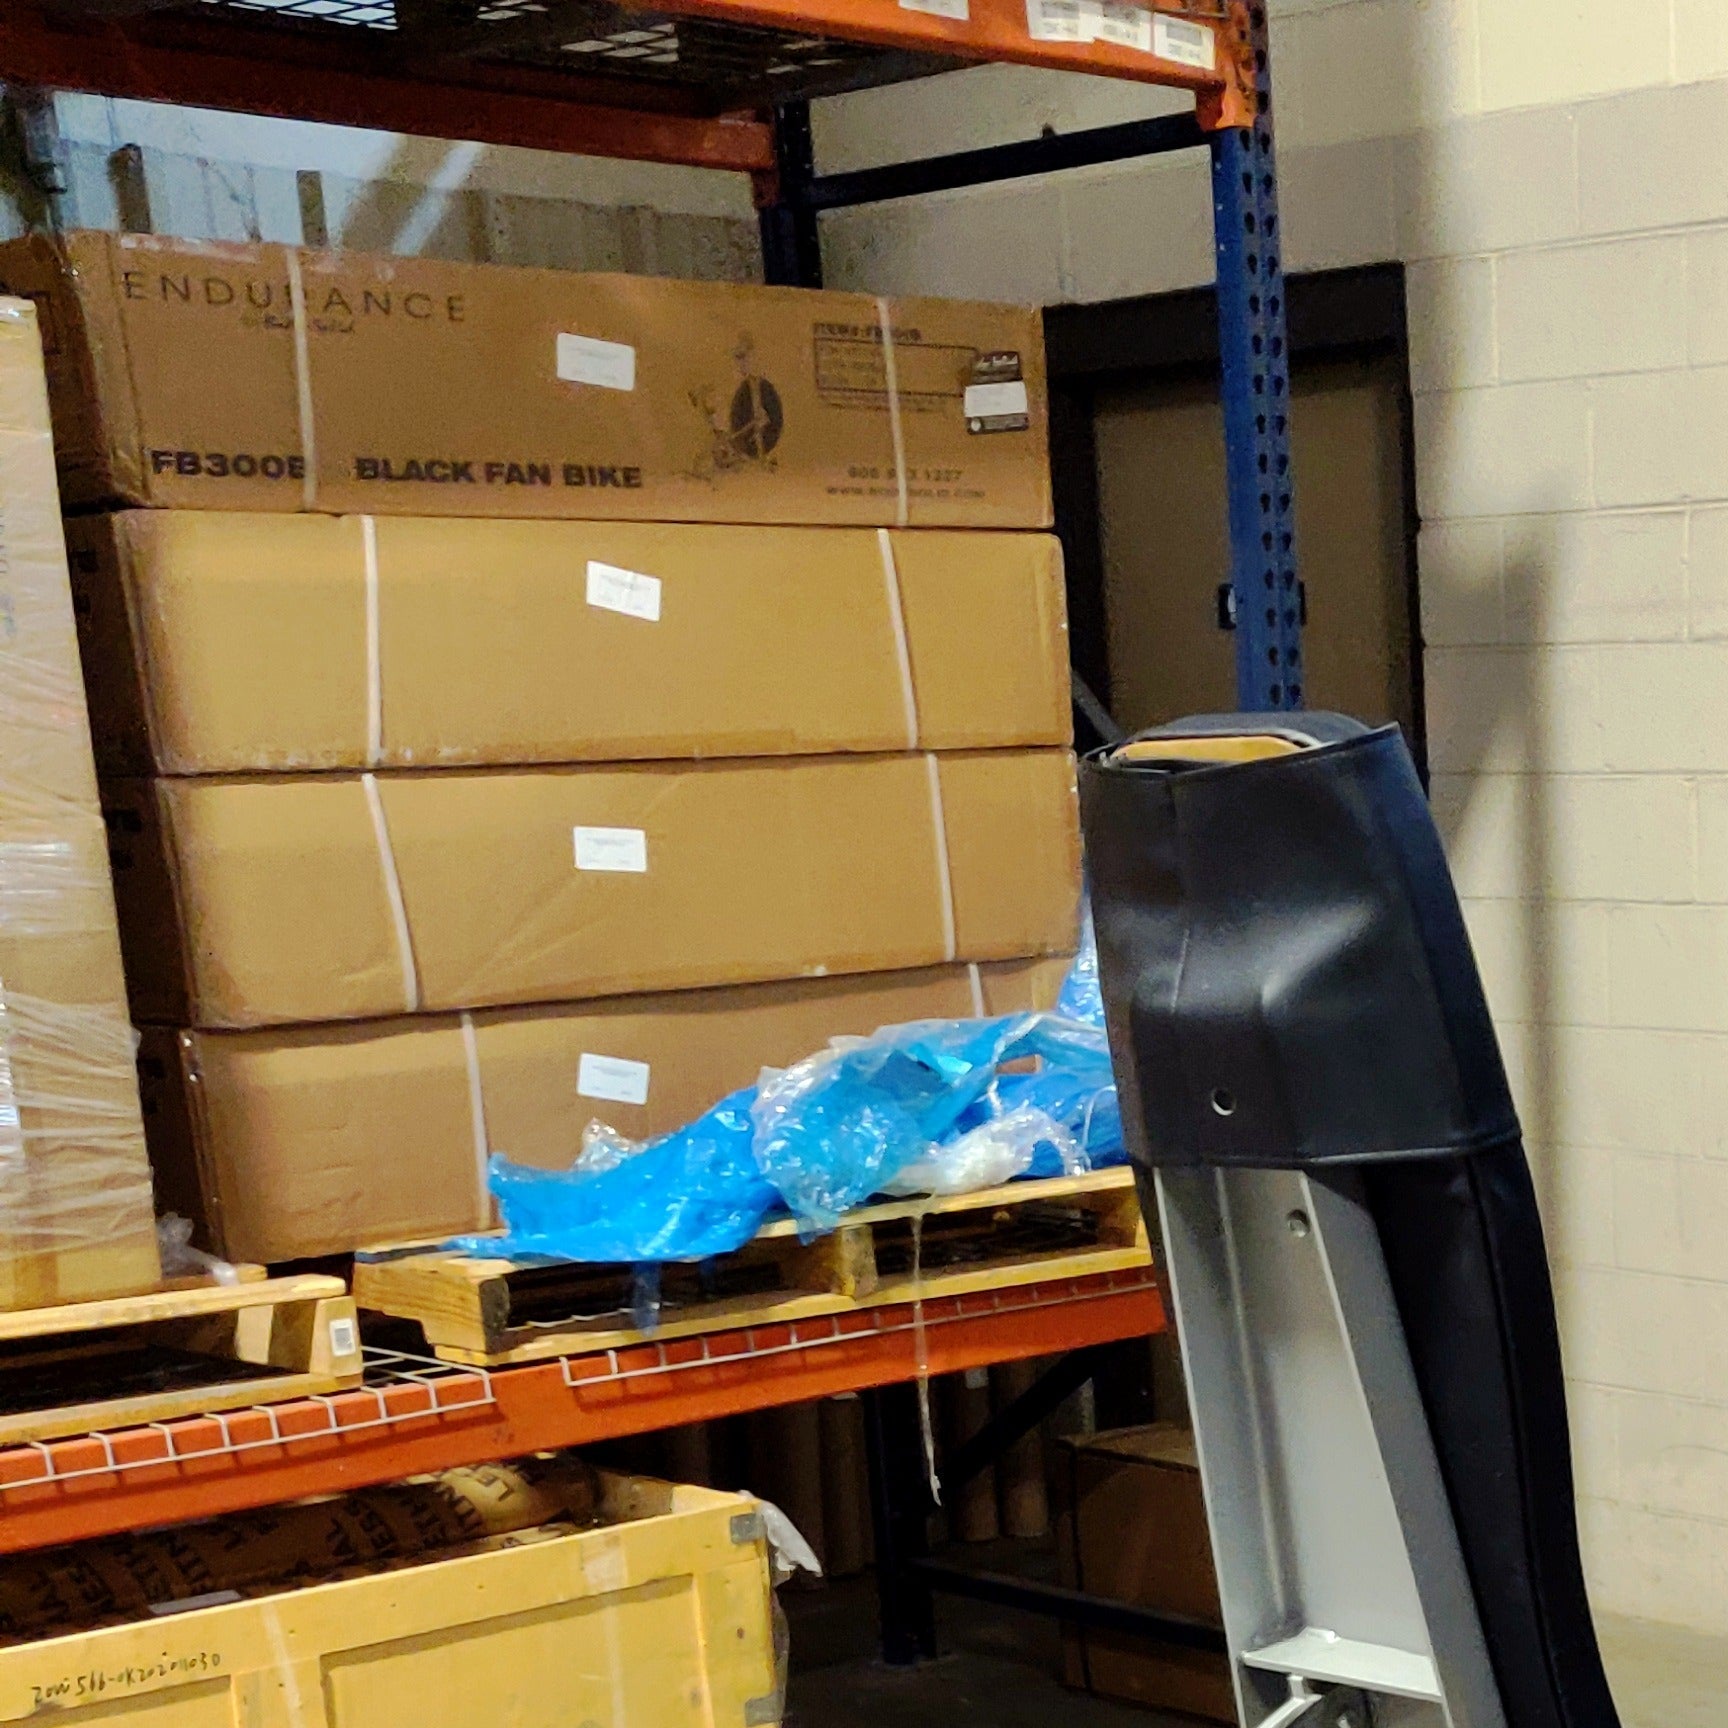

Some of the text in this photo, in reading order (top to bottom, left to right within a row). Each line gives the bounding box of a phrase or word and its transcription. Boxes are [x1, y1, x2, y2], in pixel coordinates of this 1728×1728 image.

[354, 456, 476, 484] BLACK
[484, 461, 552, 487] FAN
[562, 463, 643, 489] BIKE
